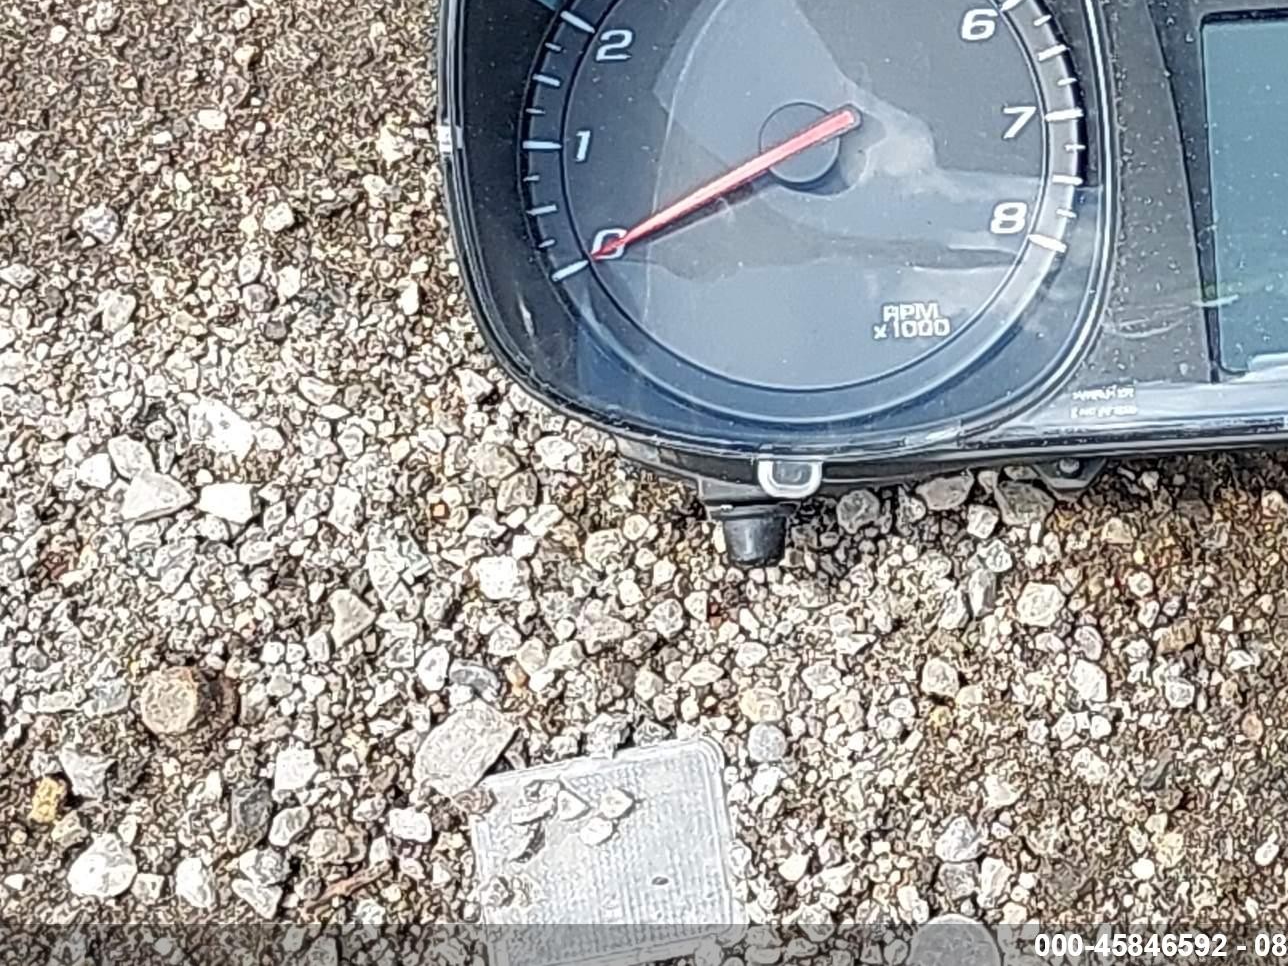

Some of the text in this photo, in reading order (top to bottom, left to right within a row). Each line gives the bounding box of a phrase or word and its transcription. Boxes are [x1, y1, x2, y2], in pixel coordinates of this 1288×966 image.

[960, 9, 997, 40] 6
[596, 30, 632, 61] 2
[1003, 106, 1036, 139] 7
[575, 132, 592, 161] 1
[991, 202, 1027, 233] 8
[594, 228, 625, 259] 0
[884, 303, 938, 321] RPM
[874, 320, 951, 339] x1000
